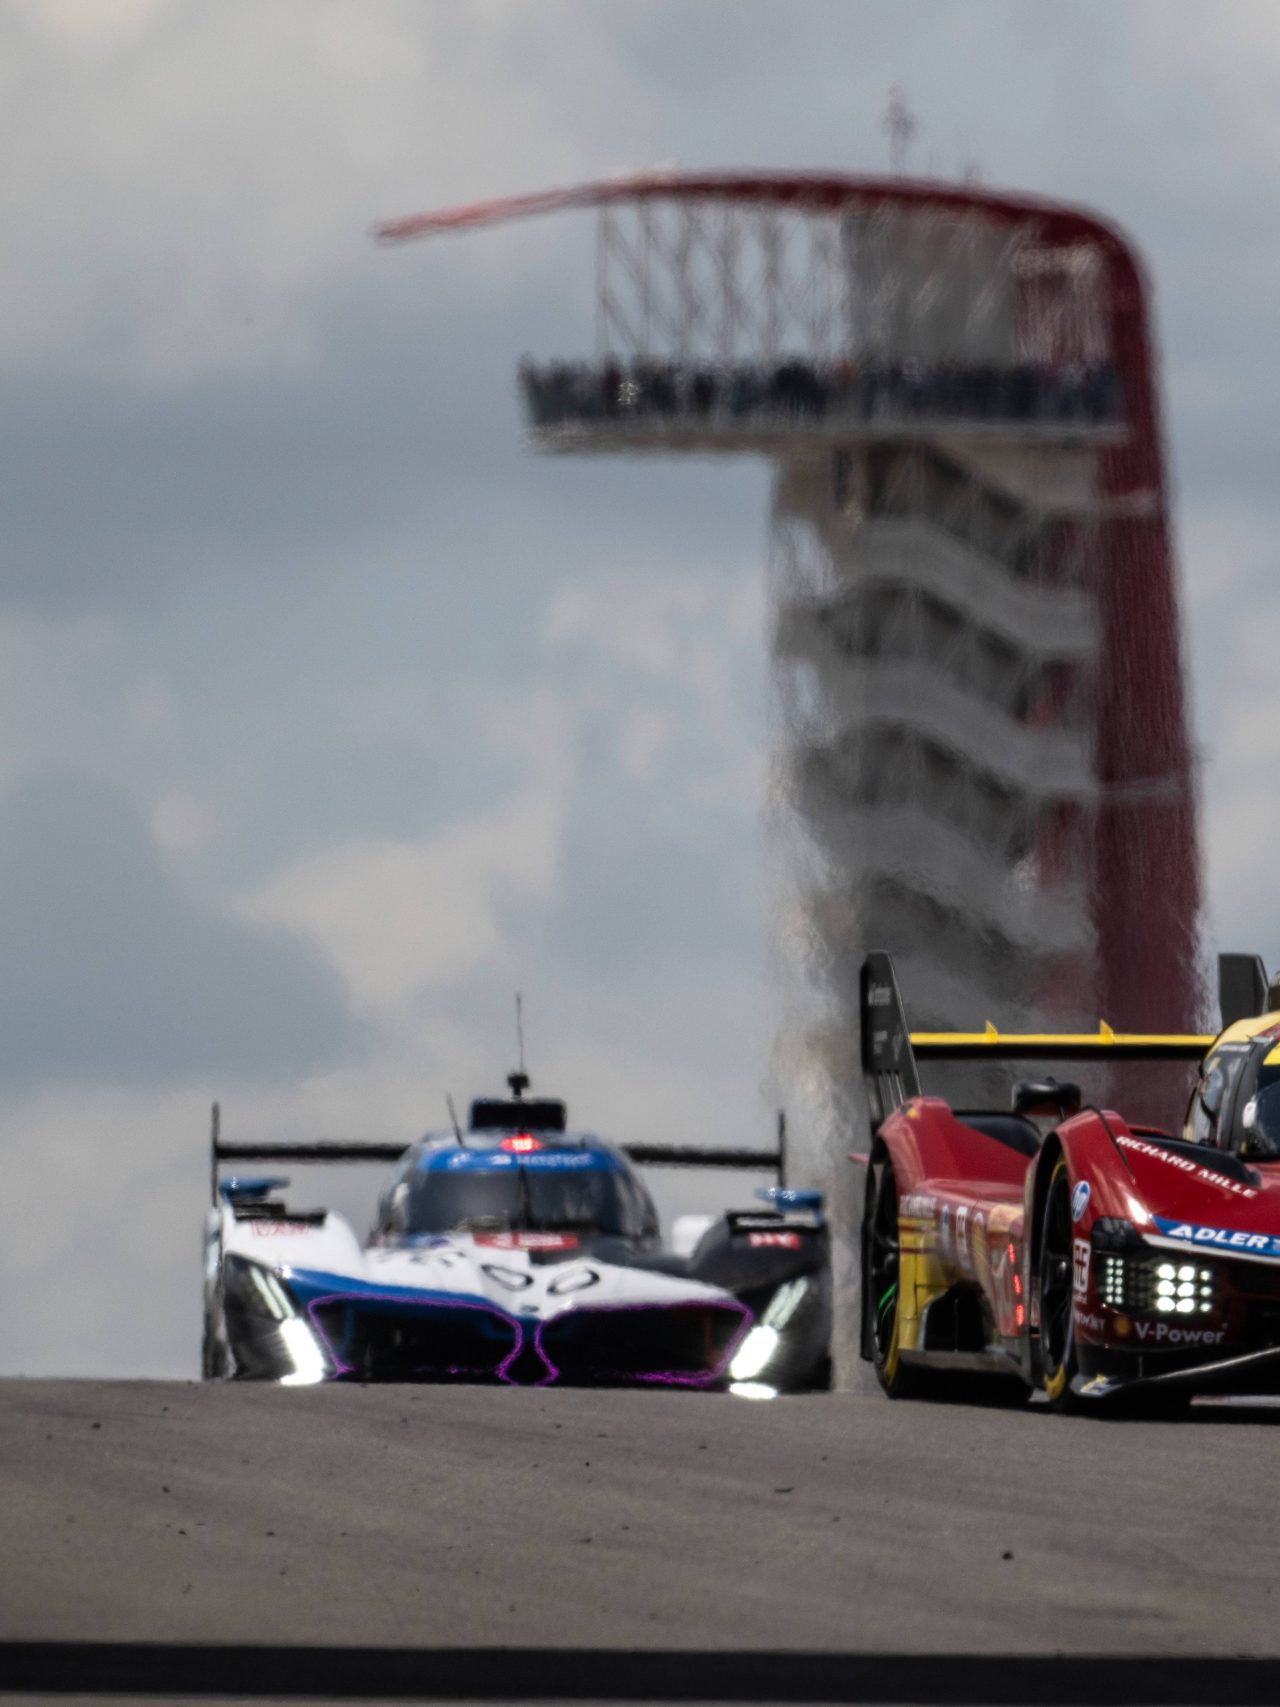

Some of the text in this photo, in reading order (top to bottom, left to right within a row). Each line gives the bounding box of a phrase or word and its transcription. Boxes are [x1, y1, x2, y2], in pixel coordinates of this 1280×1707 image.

[1115, 1136, 1258, 1198] RICHARD MILLE
[1167, 1224, 1269, 1249] ADLER
[1135, 1321, 1225, 1344] V-Power
